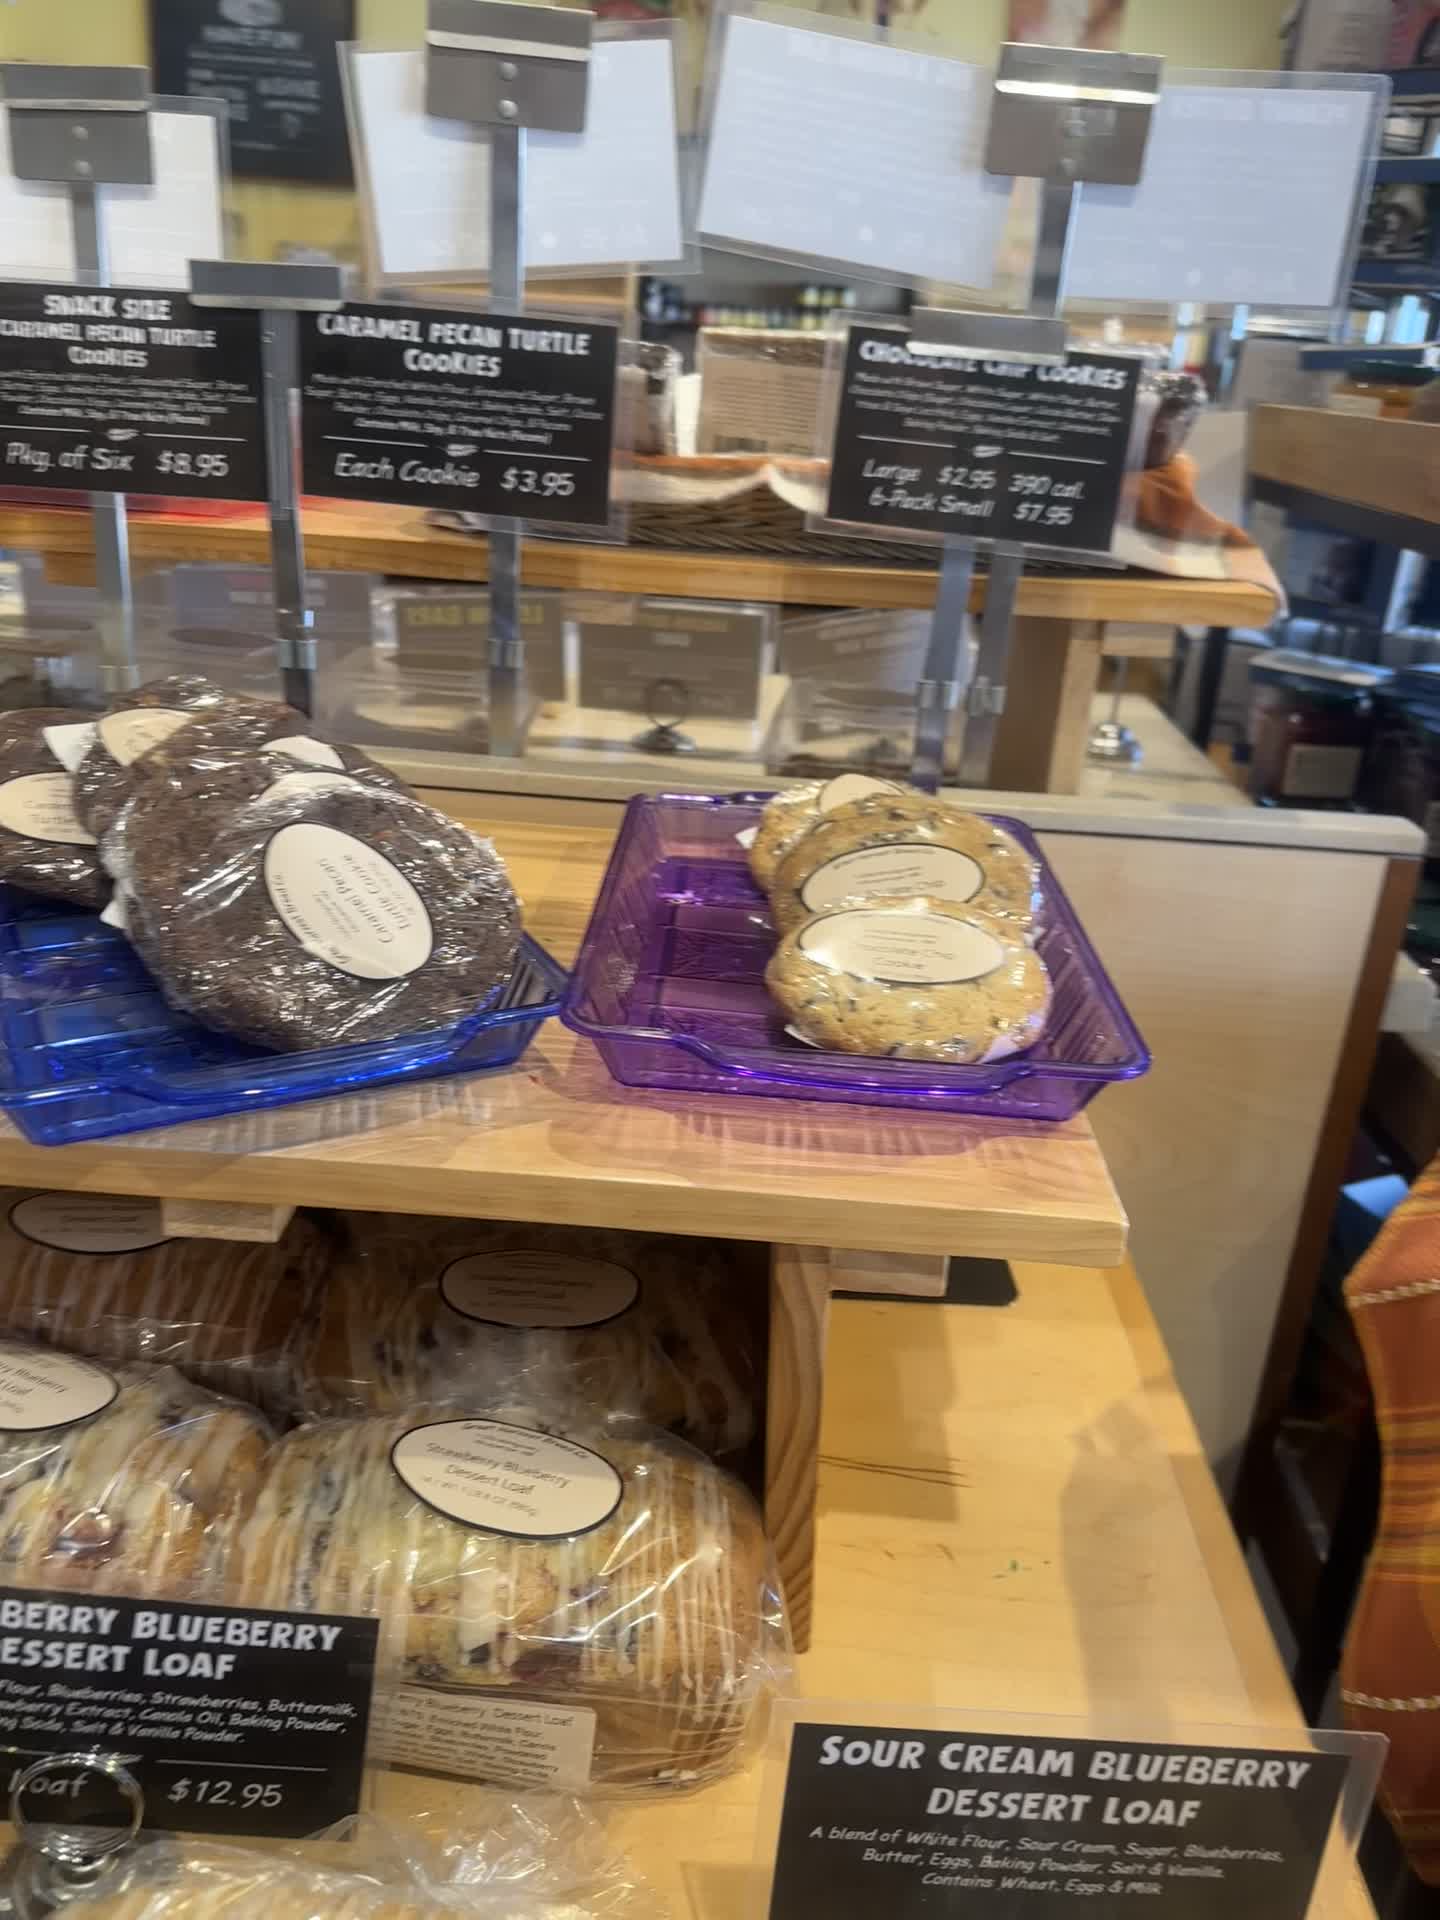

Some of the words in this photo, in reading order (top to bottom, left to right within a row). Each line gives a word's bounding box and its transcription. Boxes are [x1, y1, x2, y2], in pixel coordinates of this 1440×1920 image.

[317, 313, 423, 343] CARAMEL
[428, 322, 502, 348] PECAN
[508, 327, 592, 356] TURTLE
[58, 445, 88, 470] of
[91, 448, 135, 471] Six
[156, 451, 229, 477] $8.95
[334, 453, 395, 481] Each
[400, 460, 480, 487] Cookie
[501, 466, 576, 497] $3.95
[862, 460, 921, 486] Large
[937, 466, 998, 491] $2.95
[1008, 474, 1050, 496] 390
[938, 495, 996, 518] Small
[1013, 503, 1073, 526] $7.95
[0, 1600, 119, 1635] BERRY
[131, 1611, 343, 1651] BLUEBERRY
[143, 1649, 236, 1680] LOAF
[150, 1691, 263, 1712] Strawberries,
[108, 1721, 126, 1735] &
[128, 1723, 182, 1739] Vanilla
[183, 1726, 246, 1743] Powder.
[138, 1708, 193, 1723] Canola
[197, 1711, 225, 1727] Oil,
[229, 1713, 283, 1731] Baking
[285, 1716, 347, 1734] Powder,
[818, 1735, 923, 1770] SOUR
[938, 1742, 1074, 1778] CREAM
[1088, 1751, 1312, 1790] BLUEBERRY
[168, 1777, 283, 1808] $12.95
[926, 1788, 1091, 1822] DESSERT
[1102, 1797, 1202, 1828] LOAF
[808, 1826, 824, 1839] A
[828, 1826, 877, 1842] blend
[880, 1829, 903, 1843] of
[906, 1831, 957, 1848] White
[961, 1834, 1009, 1851] Flour,
[1016, 1837, 1060, 1851] Sour
[862, 1848, 925, 1867] Butter,
[929, 1852, 974, 1870] Eggs,
[979, 1855, 1035, 1875] Baking
[1108, 1861, 1147, 1876] Salt
[1149, 1862, 1165, 1876] &
[921, 1872, 994, 1889] Contains
[1064, 1878, 1106, 1896] Eggs
[1107, 1880, 1123, 1894] &
